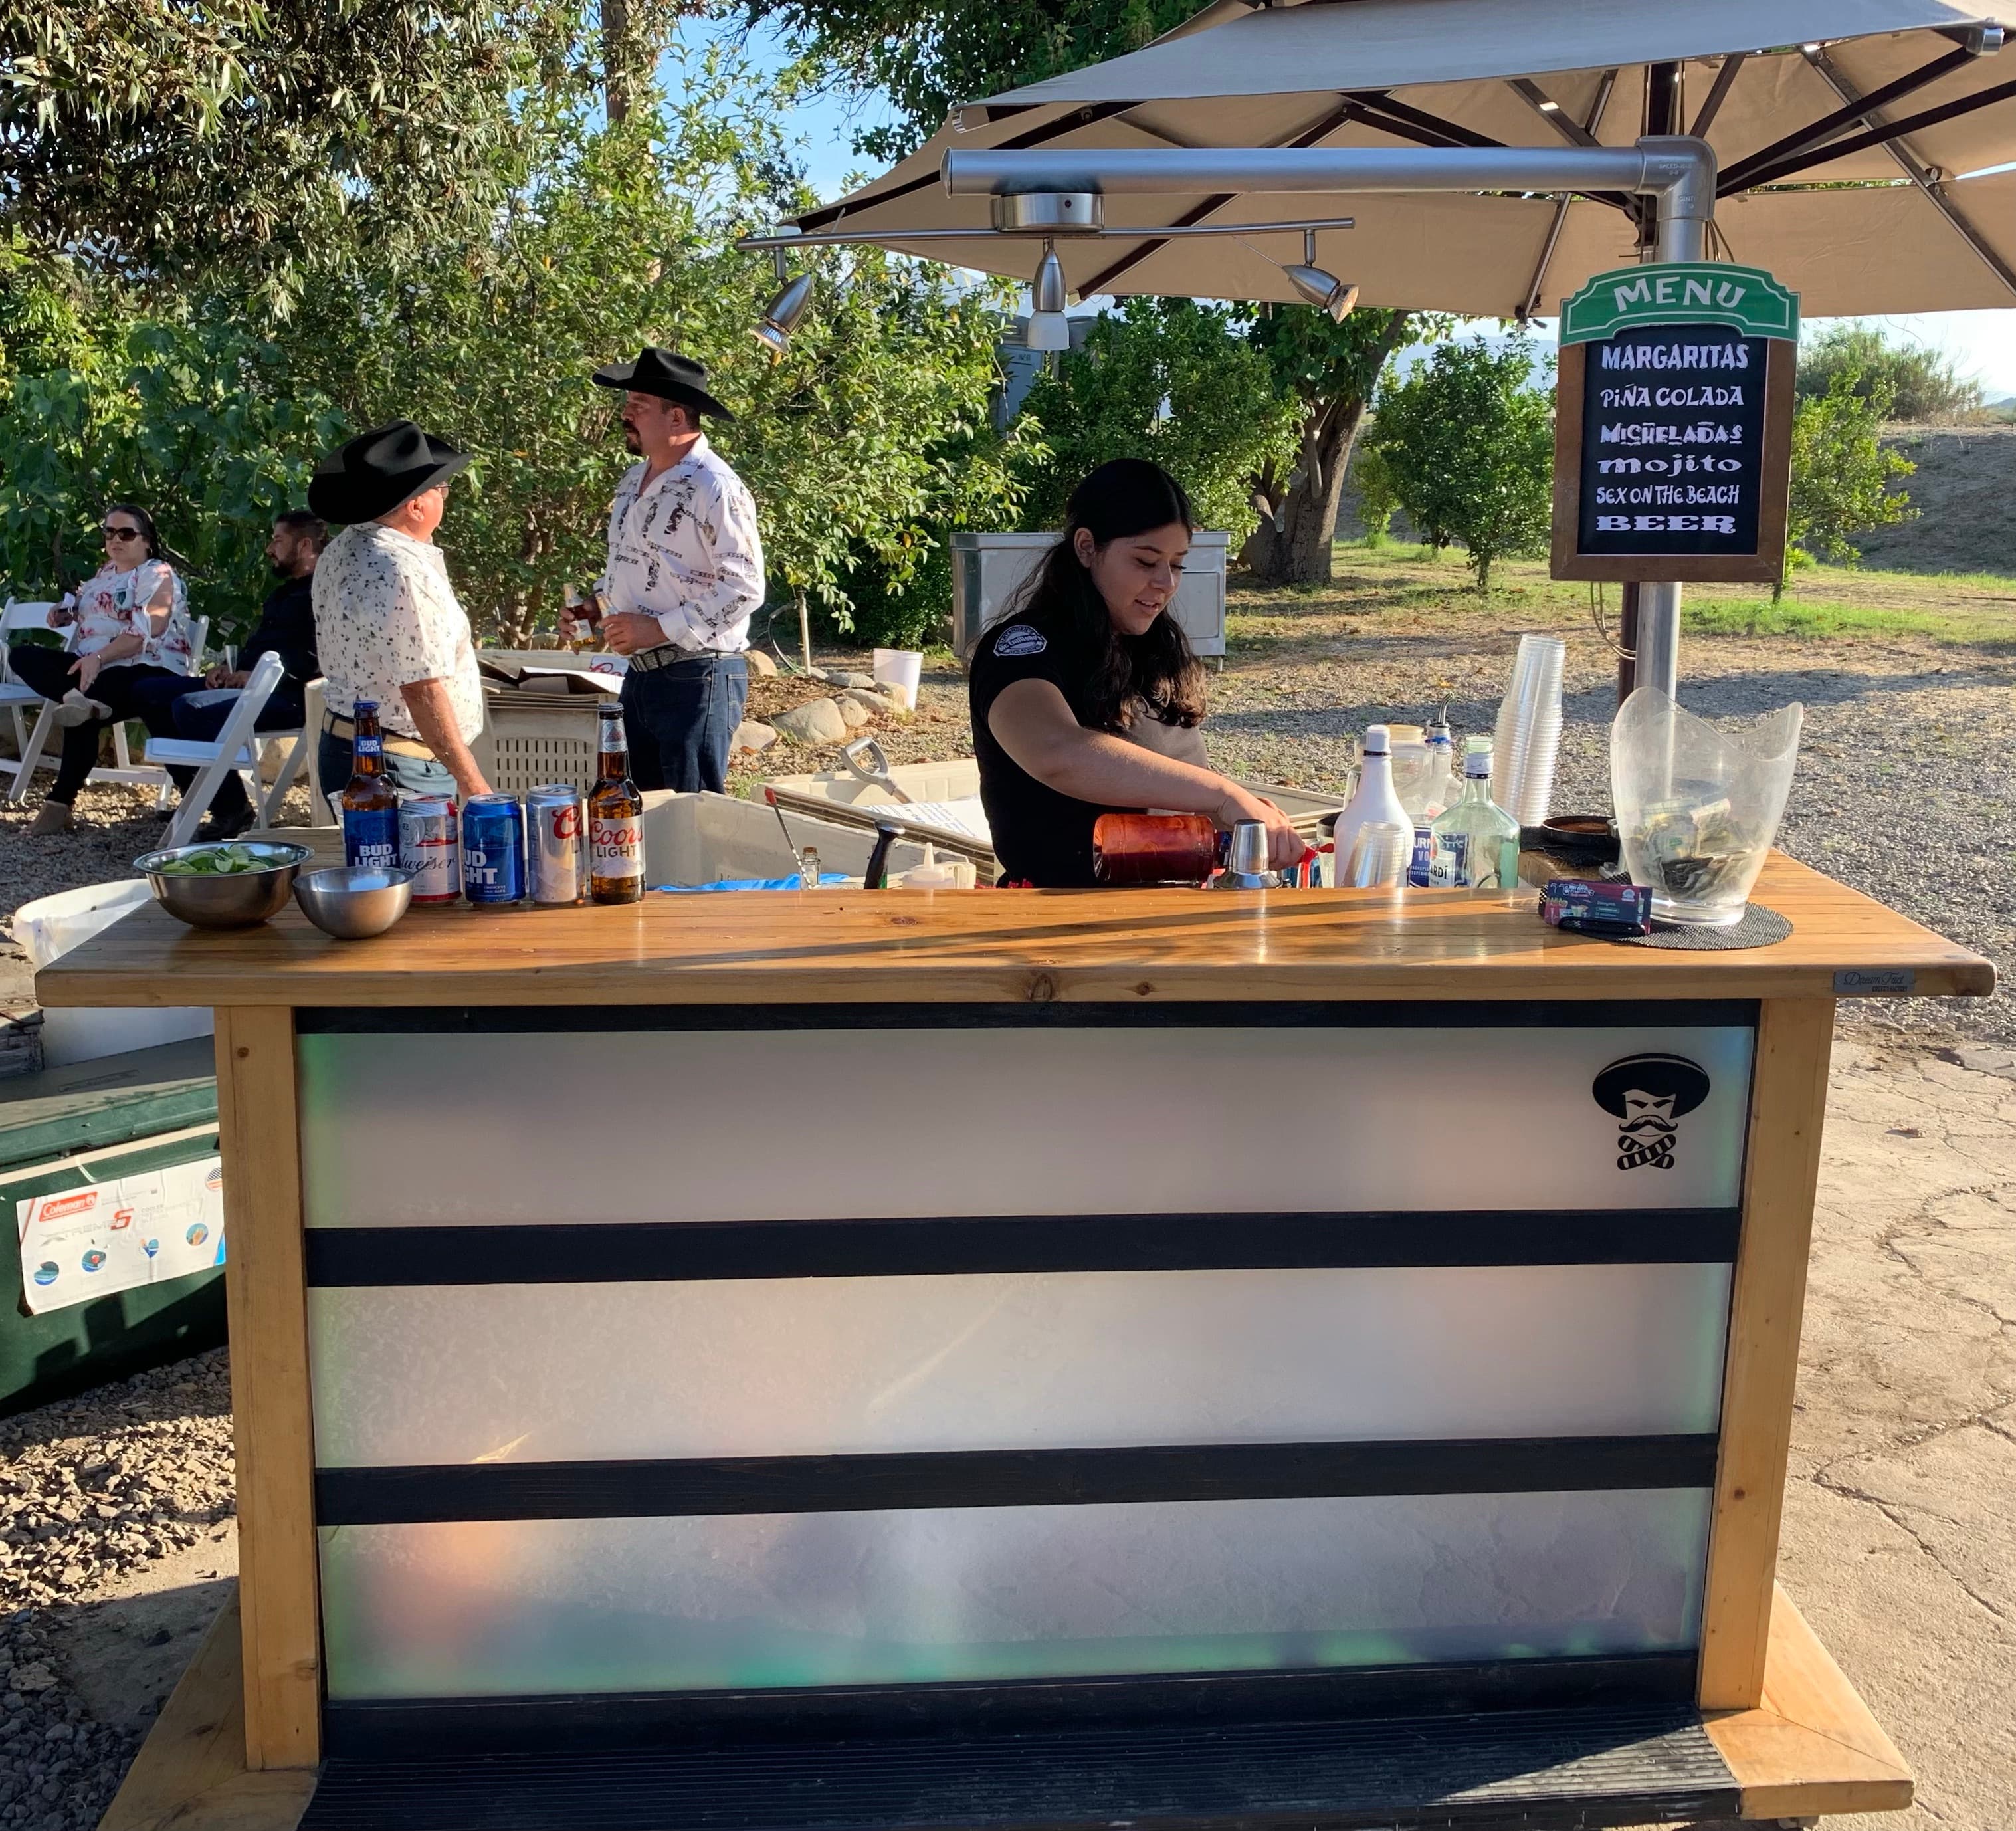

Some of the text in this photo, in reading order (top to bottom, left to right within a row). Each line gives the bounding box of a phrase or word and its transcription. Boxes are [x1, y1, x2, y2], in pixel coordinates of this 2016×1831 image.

[1613, 276, 1747, 312] MENU
[1601, 343, 1750, 371] MARGARITAS
[1655, 385, 1744, 407] COLADA
[1597, 453, 1742, 477] mojito
[1629, 485, 1653, 504] ON
[1655, 485, 1684, 505] THE
[1685, 485, 1740, 504] BEACH
[1595, 515, 1736, 534] BEER
[589, 821, 643, 845] Coors
[359, 843, 393, 857] BUD
[465, 850, 487, 867] UD
[597, 845, 637, 858] LIGHT
[355, 853, 397, 867] LIGHT
[465, 867, 498, 885] GHT
[43, 1199, 85, 1216] Coleman
